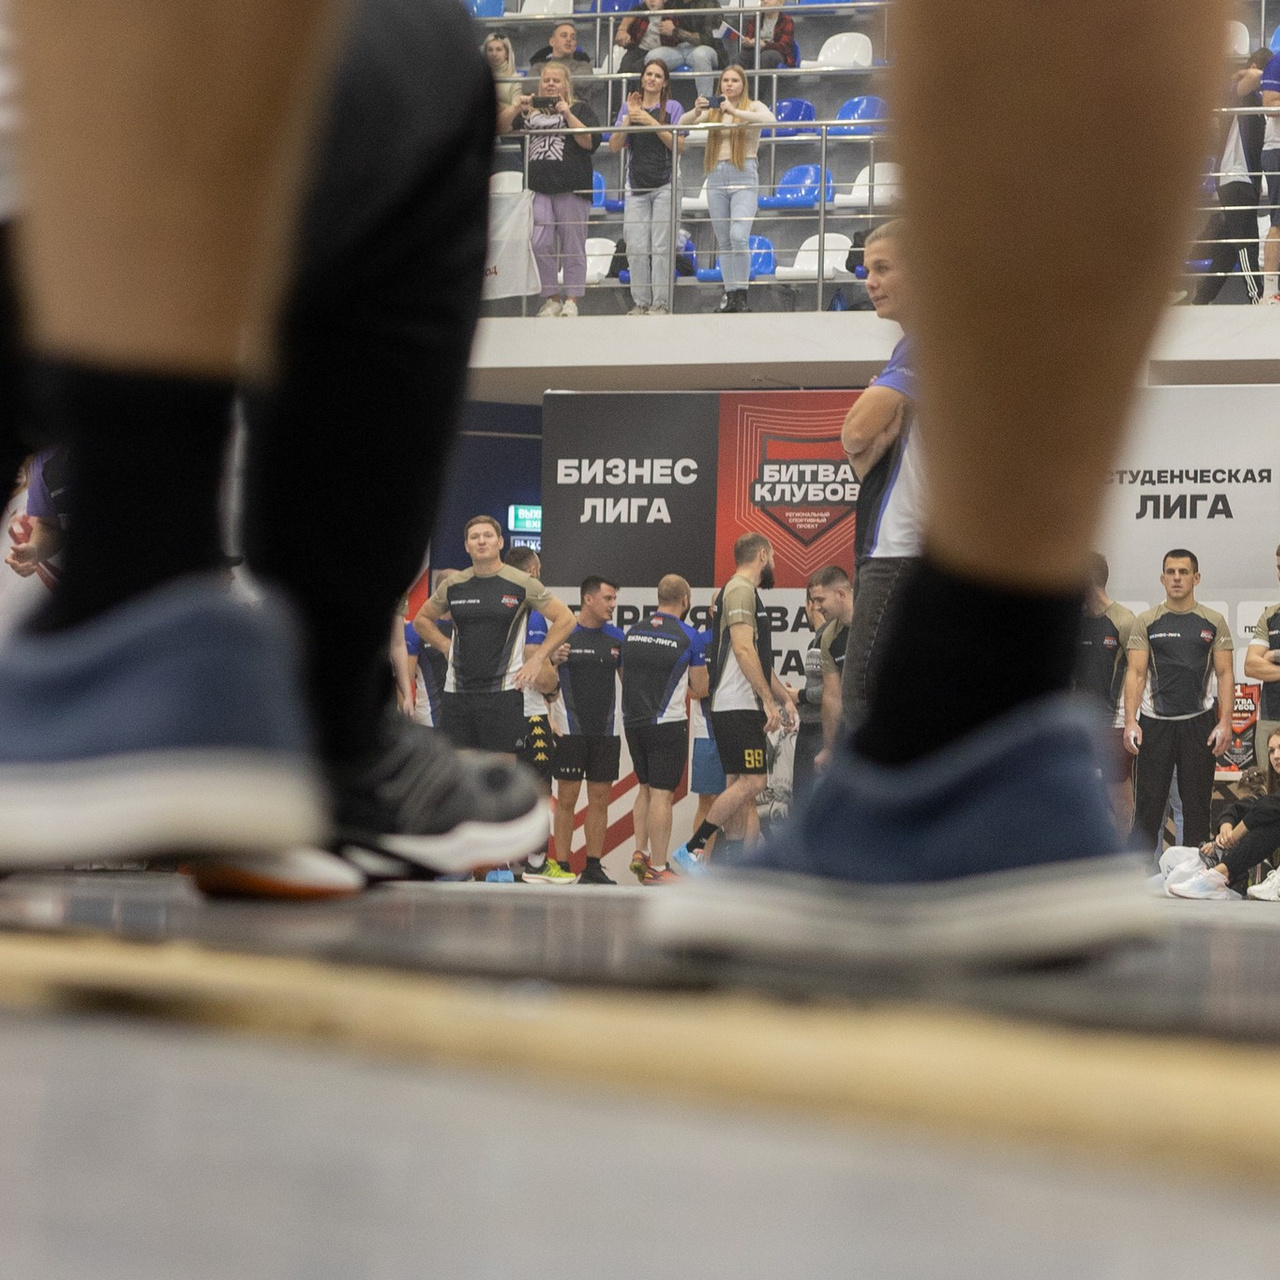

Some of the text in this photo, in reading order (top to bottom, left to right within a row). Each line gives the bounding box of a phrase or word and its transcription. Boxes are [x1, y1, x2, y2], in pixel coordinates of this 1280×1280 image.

[557, 458, 699, 485] БИЗНЕС
[763, 464, 855, 482] БИТВА
[754, 483, 861, 503] КЛУБОВ
[518, 508, 541, 519] ВЫХ
[580, 497, 672, 524] ЛИГА
[1135, 494, 1234, 520] ЛИГА
[744, 748, 763, 768] 99
